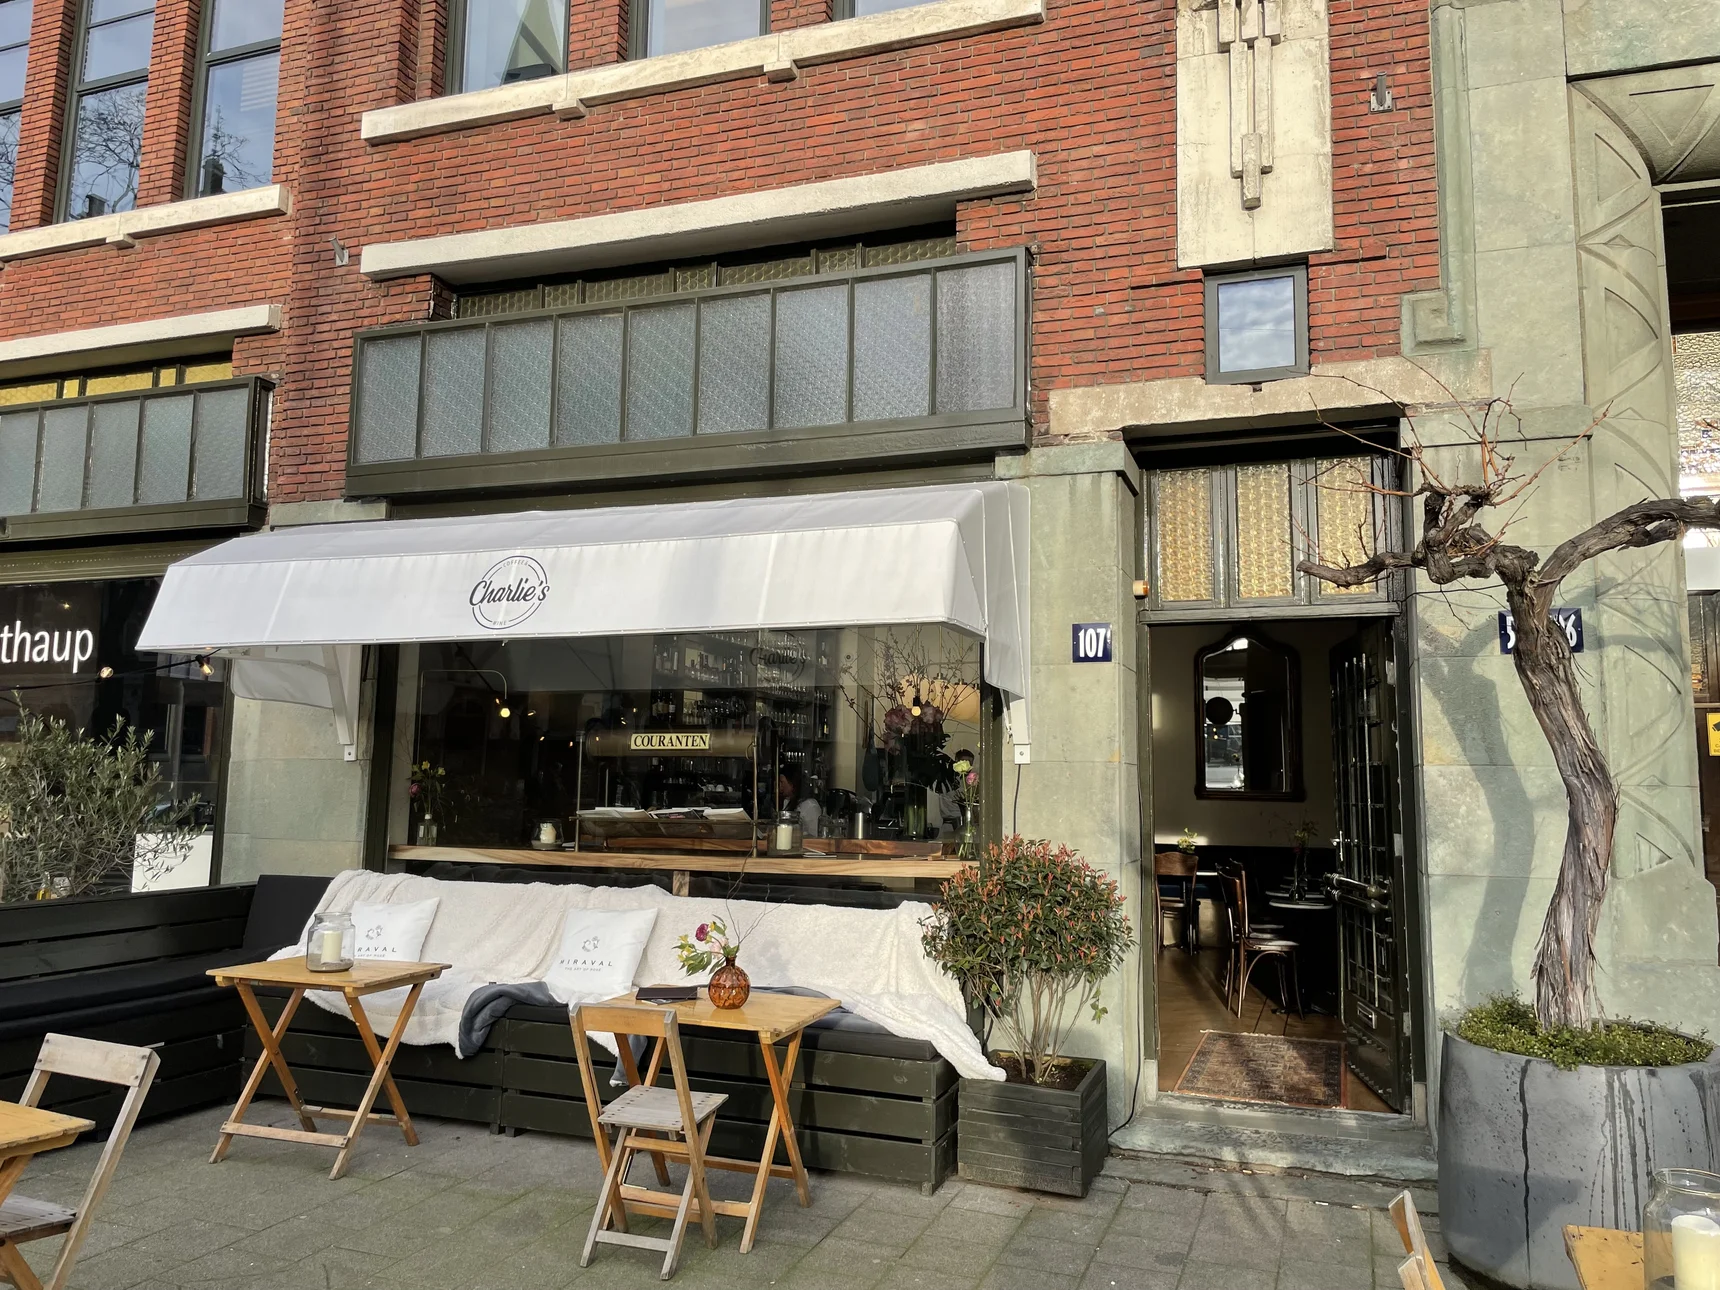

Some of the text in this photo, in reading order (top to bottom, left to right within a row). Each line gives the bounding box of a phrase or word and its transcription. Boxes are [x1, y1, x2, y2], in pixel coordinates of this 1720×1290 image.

[469, 577, 550, 606] Charlie's
[0, 619, 94, 674] thaup
[1078, 628, 1106, 658] 107
[634, 735, 708, 747] COURANTEN
